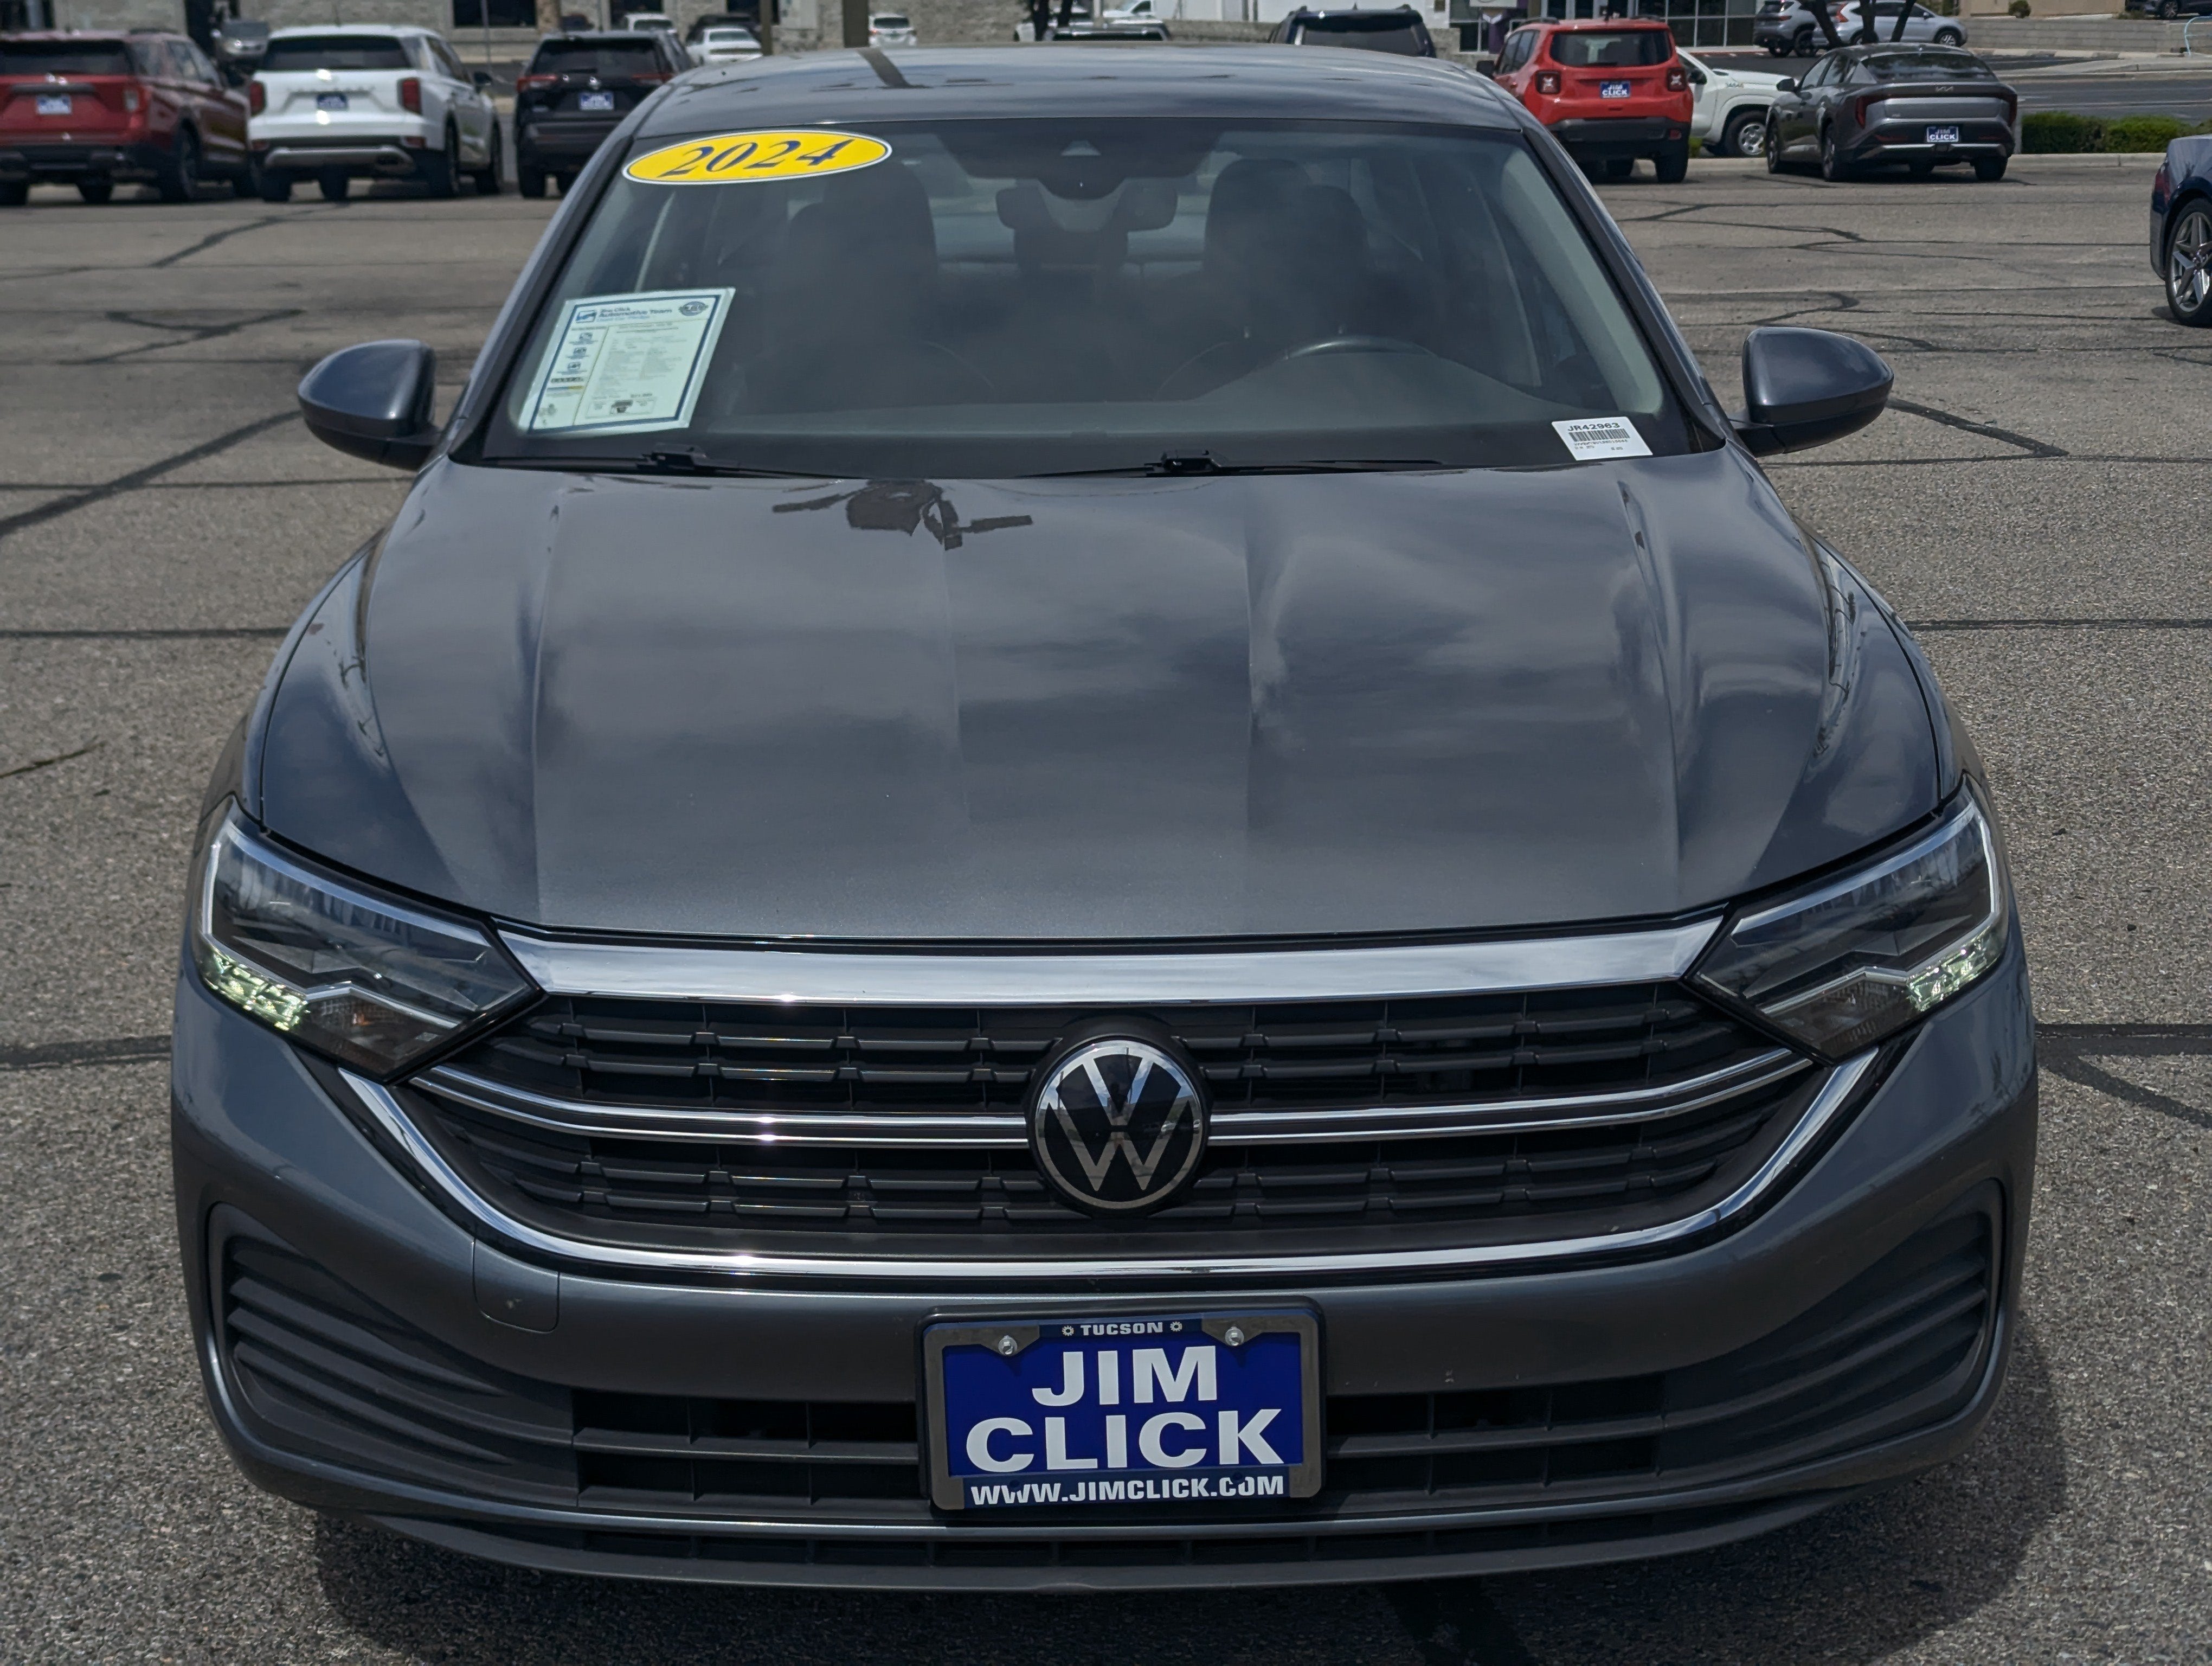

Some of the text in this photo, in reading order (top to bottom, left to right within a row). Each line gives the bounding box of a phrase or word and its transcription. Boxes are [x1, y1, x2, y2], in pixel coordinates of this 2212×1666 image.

[657, 139, 855, 178] 2024
[1567, 422, 1621, 432] JR42963
[1080, 1322, 1163, 1336] TUCSON
[1031, 1345, 1218, 1407] JIM
[966, 1408, 1284, 1473] CLICK
[970, 1475, 1284, 1506] WWW.JIMCLICK.COM
